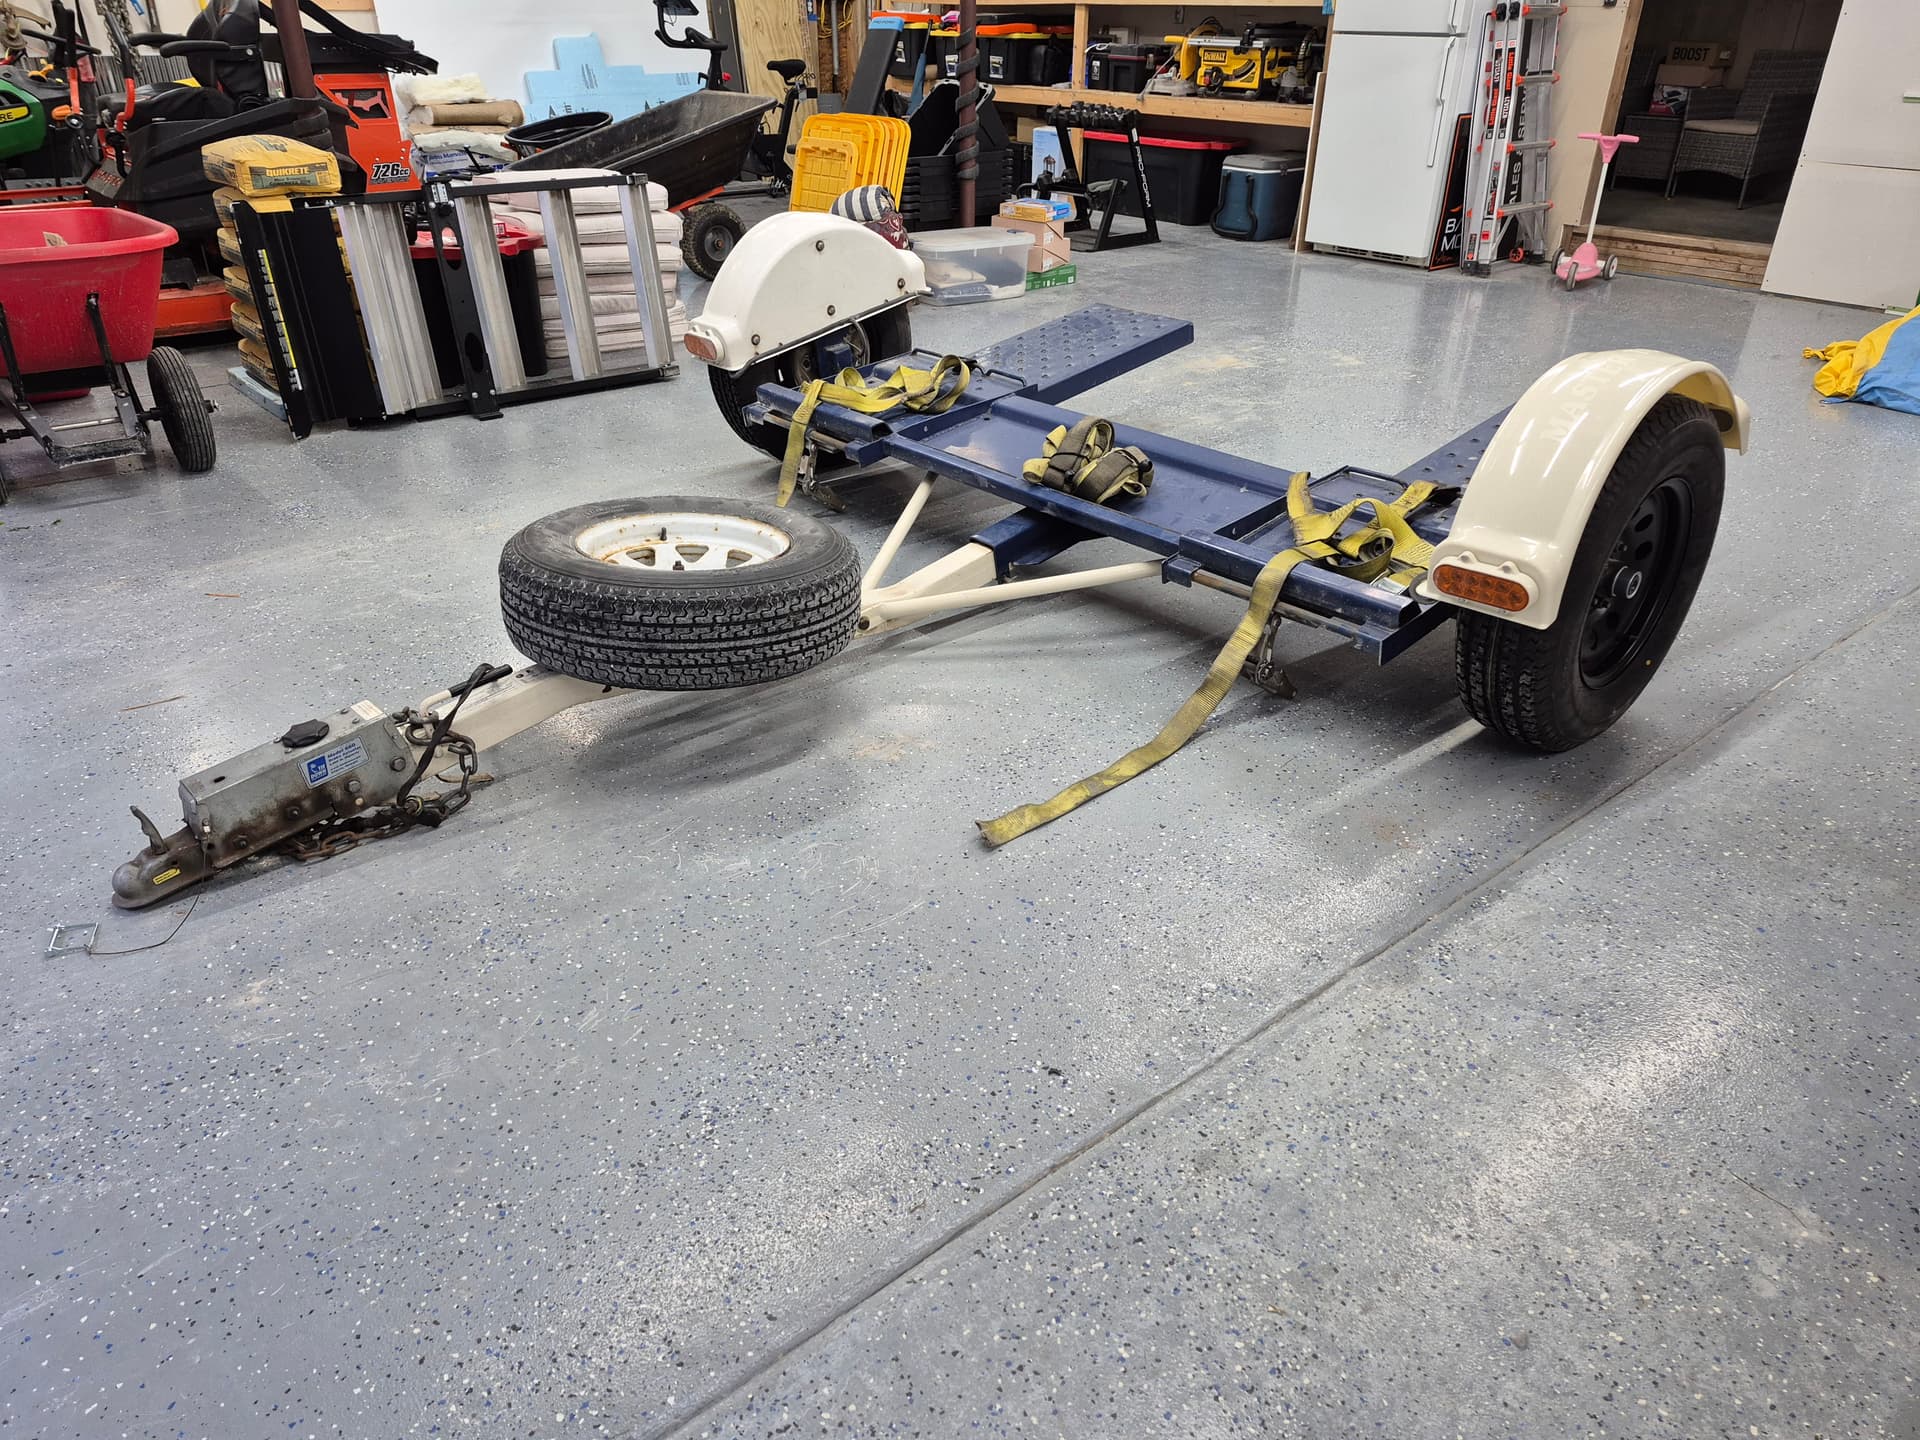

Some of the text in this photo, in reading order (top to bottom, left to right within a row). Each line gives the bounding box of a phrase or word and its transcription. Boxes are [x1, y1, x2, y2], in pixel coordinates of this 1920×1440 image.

[1672, 47, 1710, 61] BOOST
[266, 166, 310, 177] QUIKRETE
[372, 162, 410, 179] 726cc
